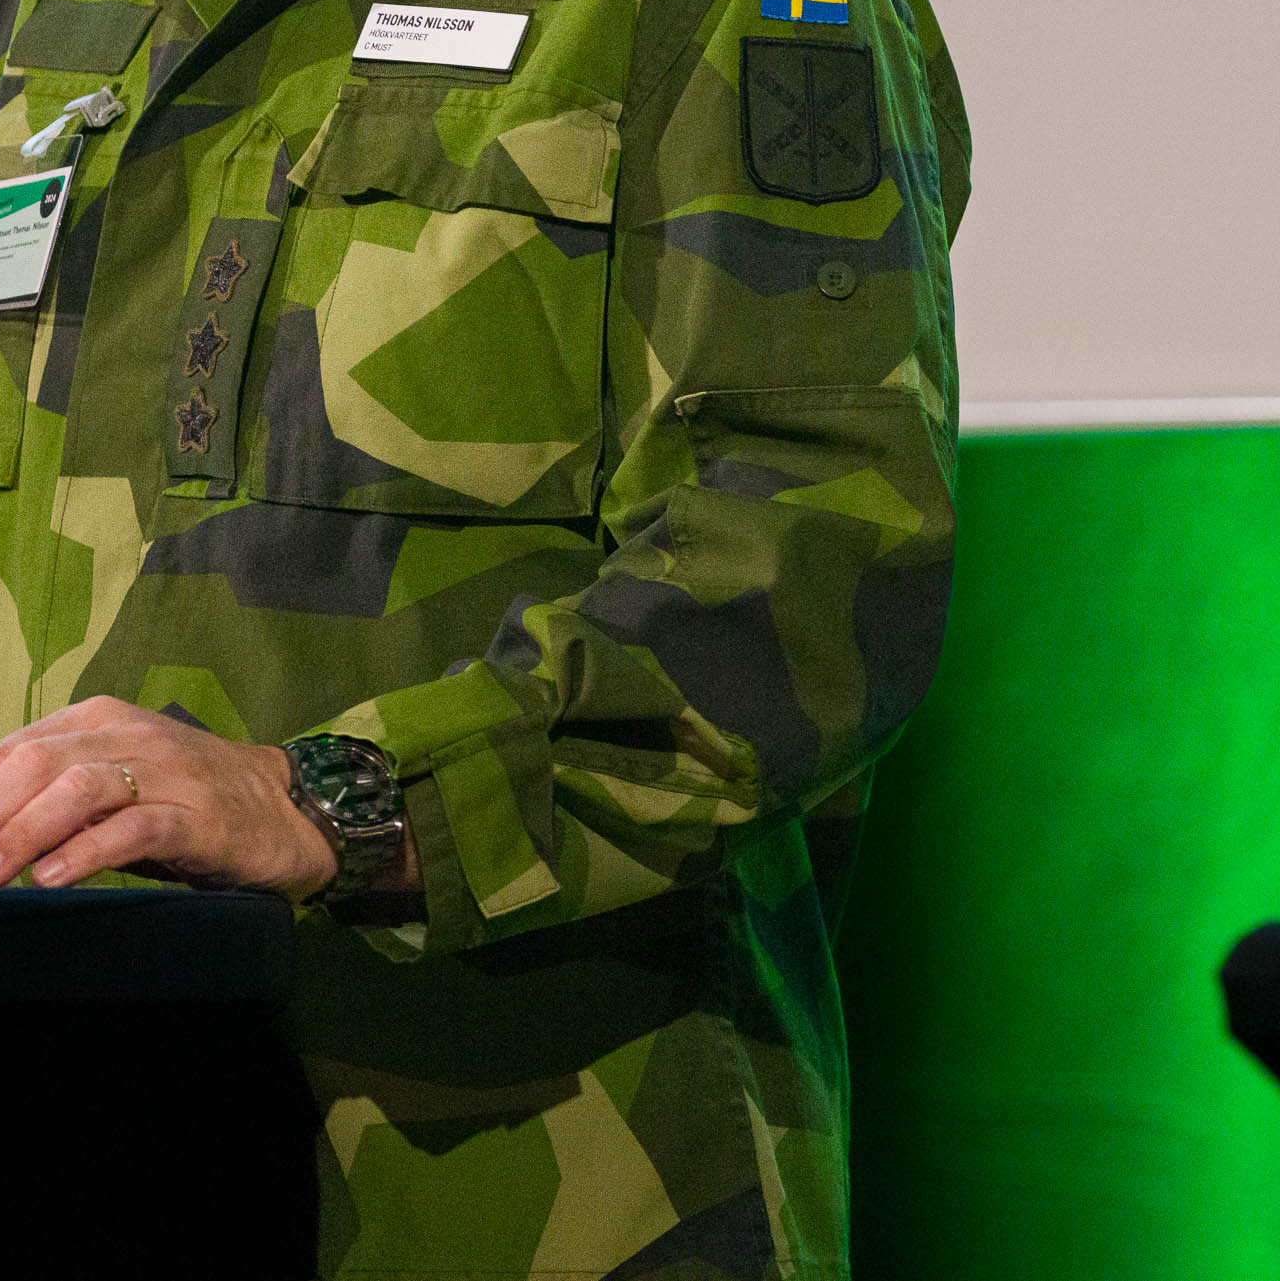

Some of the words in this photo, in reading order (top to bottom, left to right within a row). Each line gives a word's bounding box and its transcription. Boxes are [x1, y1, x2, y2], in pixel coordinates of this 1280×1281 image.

[376, 13, 423, 28] THOMAS
[424, 17, 475, 31] NILSSON
[369, 29, 429, 41] HÖGKVARTERET
[364, 42, 370, 50] C
[371, 43, 392, 52] MUST
